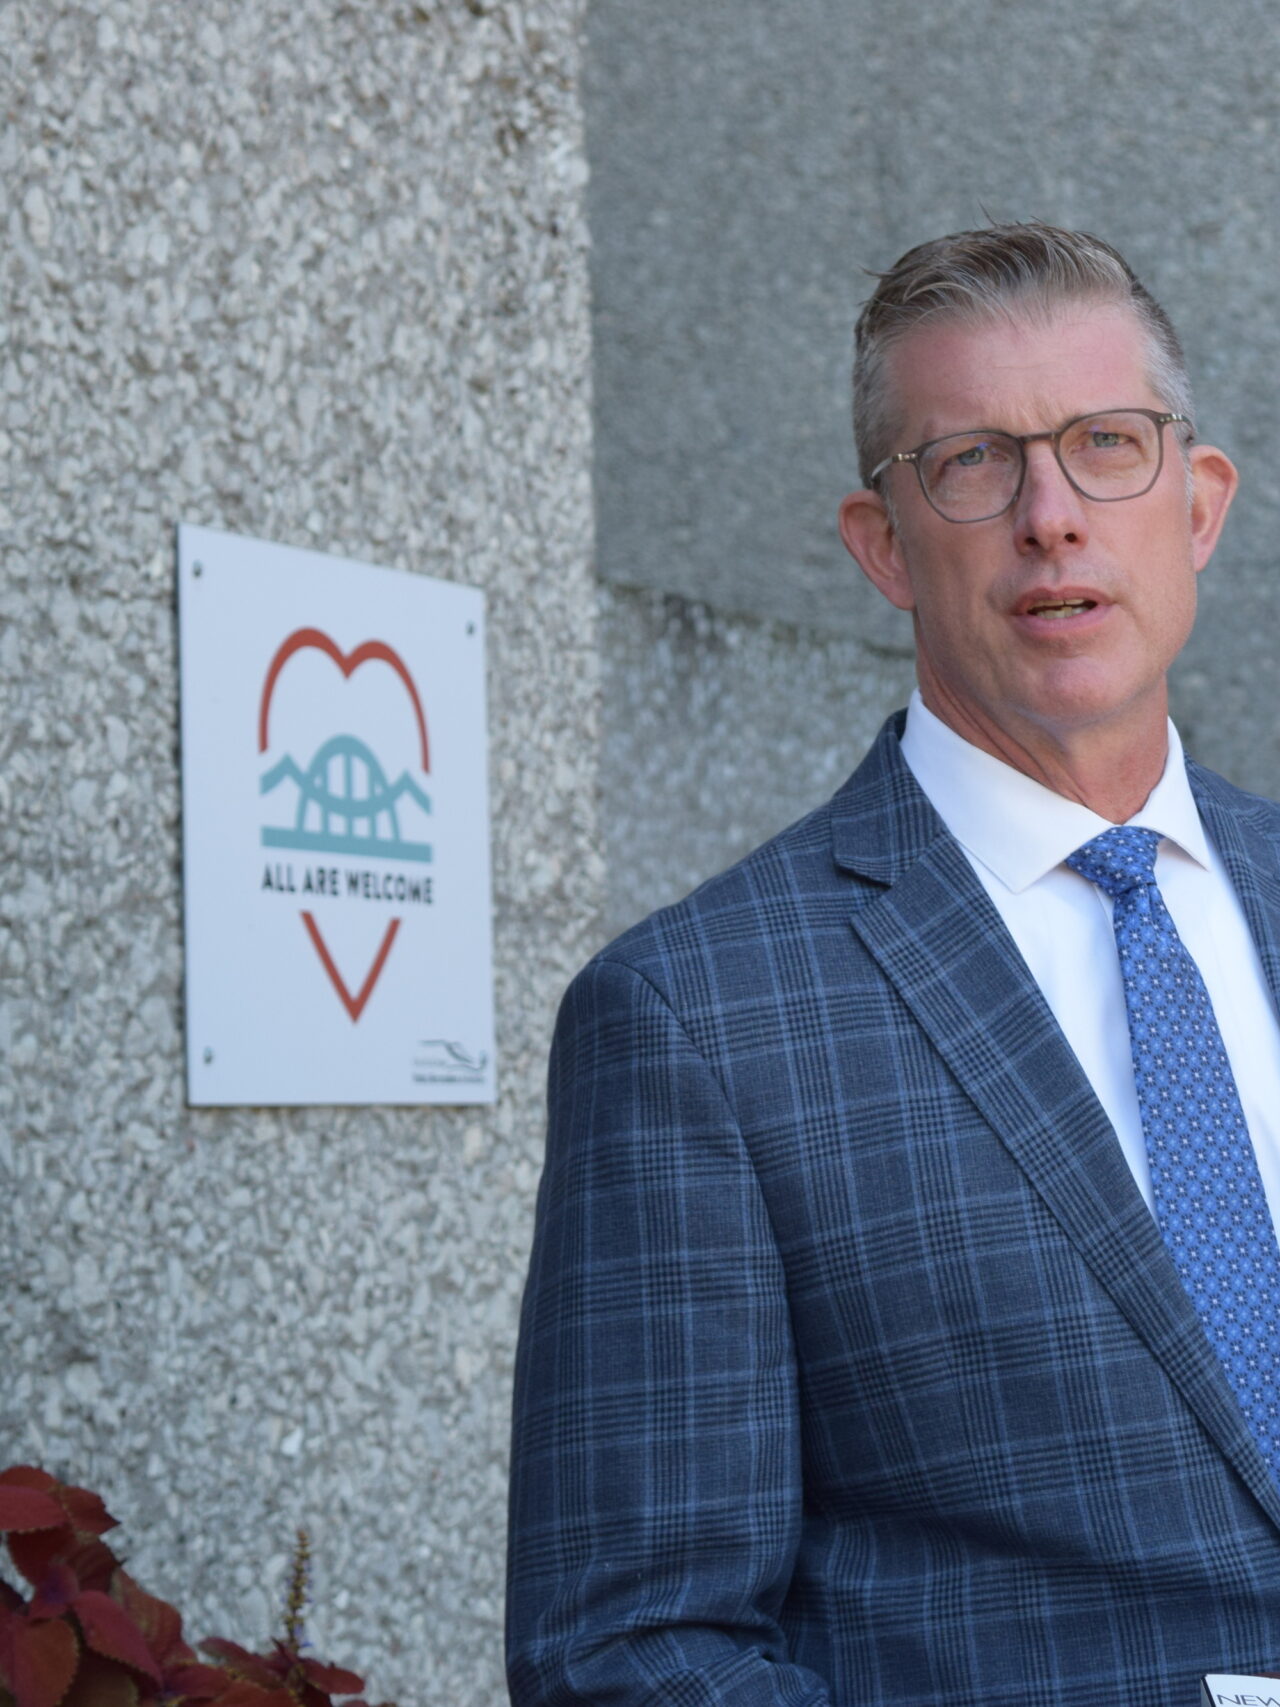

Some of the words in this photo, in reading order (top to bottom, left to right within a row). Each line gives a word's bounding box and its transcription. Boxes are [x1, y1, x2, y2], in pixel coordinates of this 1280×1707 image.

[262, 863, 296, 893] ALL
[302, 865, 339, 897] ARE
[345, 869, 434, 905] WELCOME
